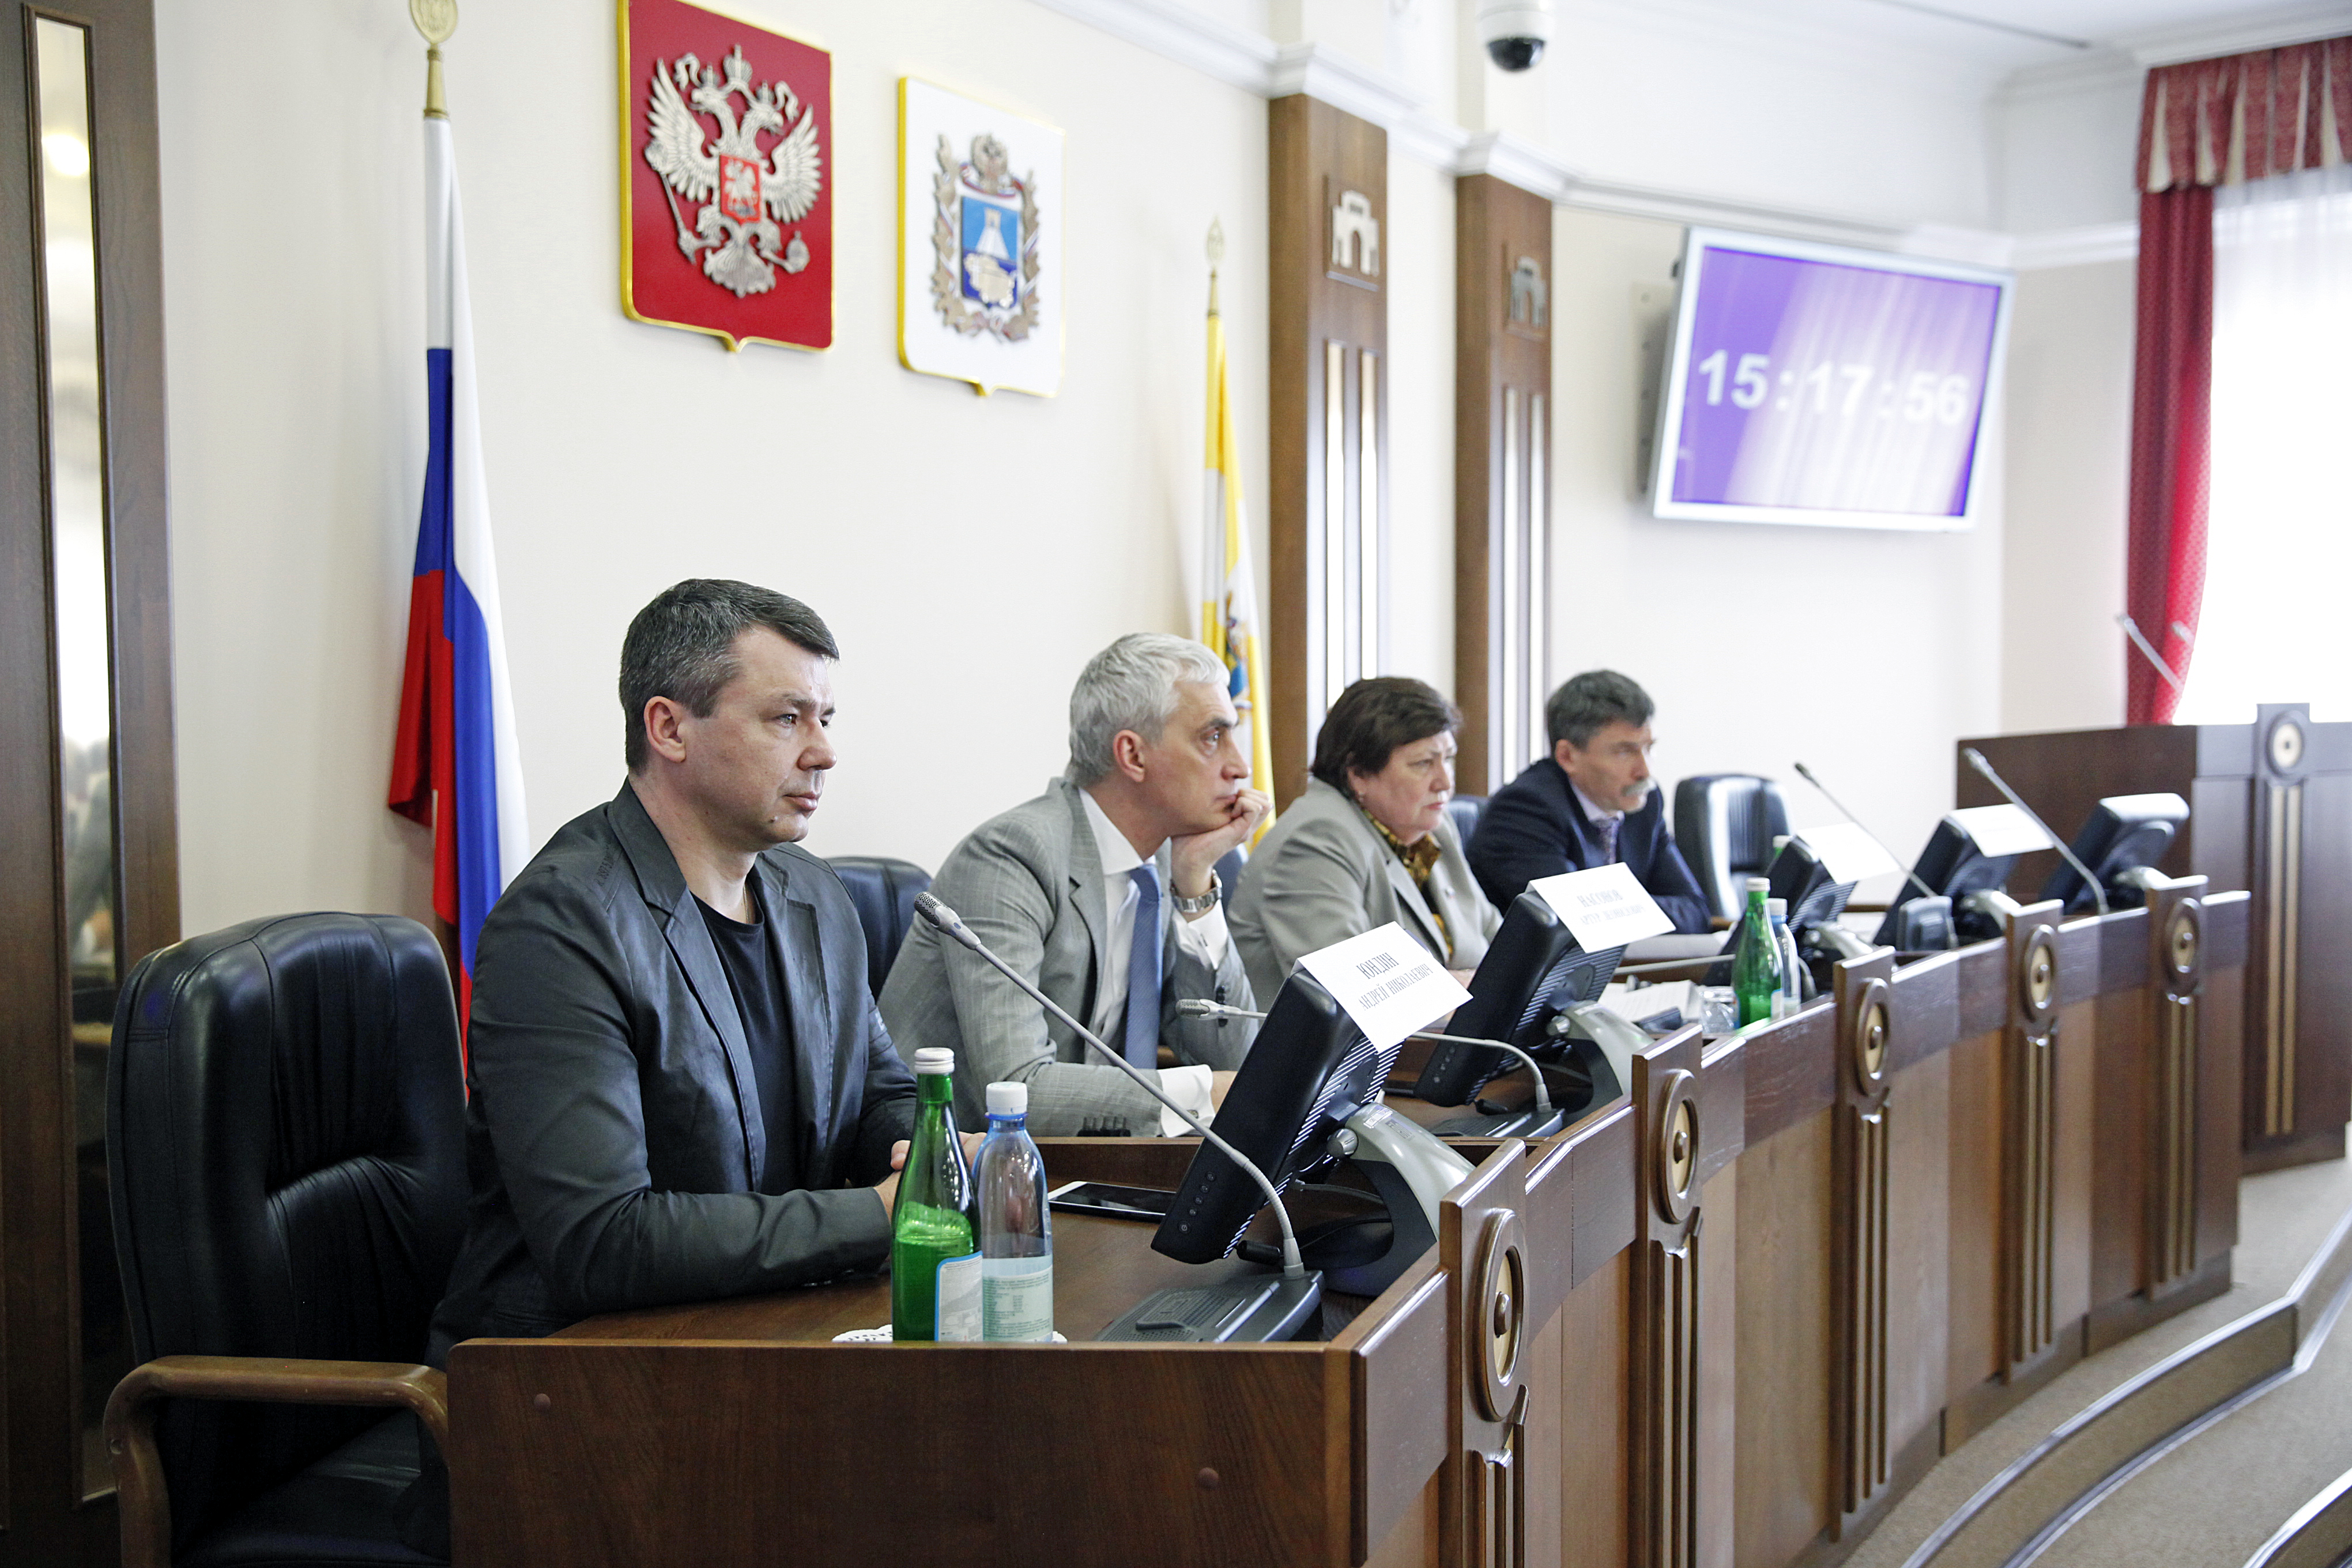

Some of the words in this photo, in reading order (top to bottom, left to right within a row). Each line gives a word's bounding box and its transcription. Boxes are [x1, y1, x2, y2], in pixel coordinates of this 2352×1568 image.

[1698, 349, 1971, 425] 15:17:56
[1356, 952, 1400, 979] ЮНДИН
[1358, 983, 1390, 1011] АНДРЕЙ
[1385, 963, 1434, 994] НИКОЛАЕВИЧ
